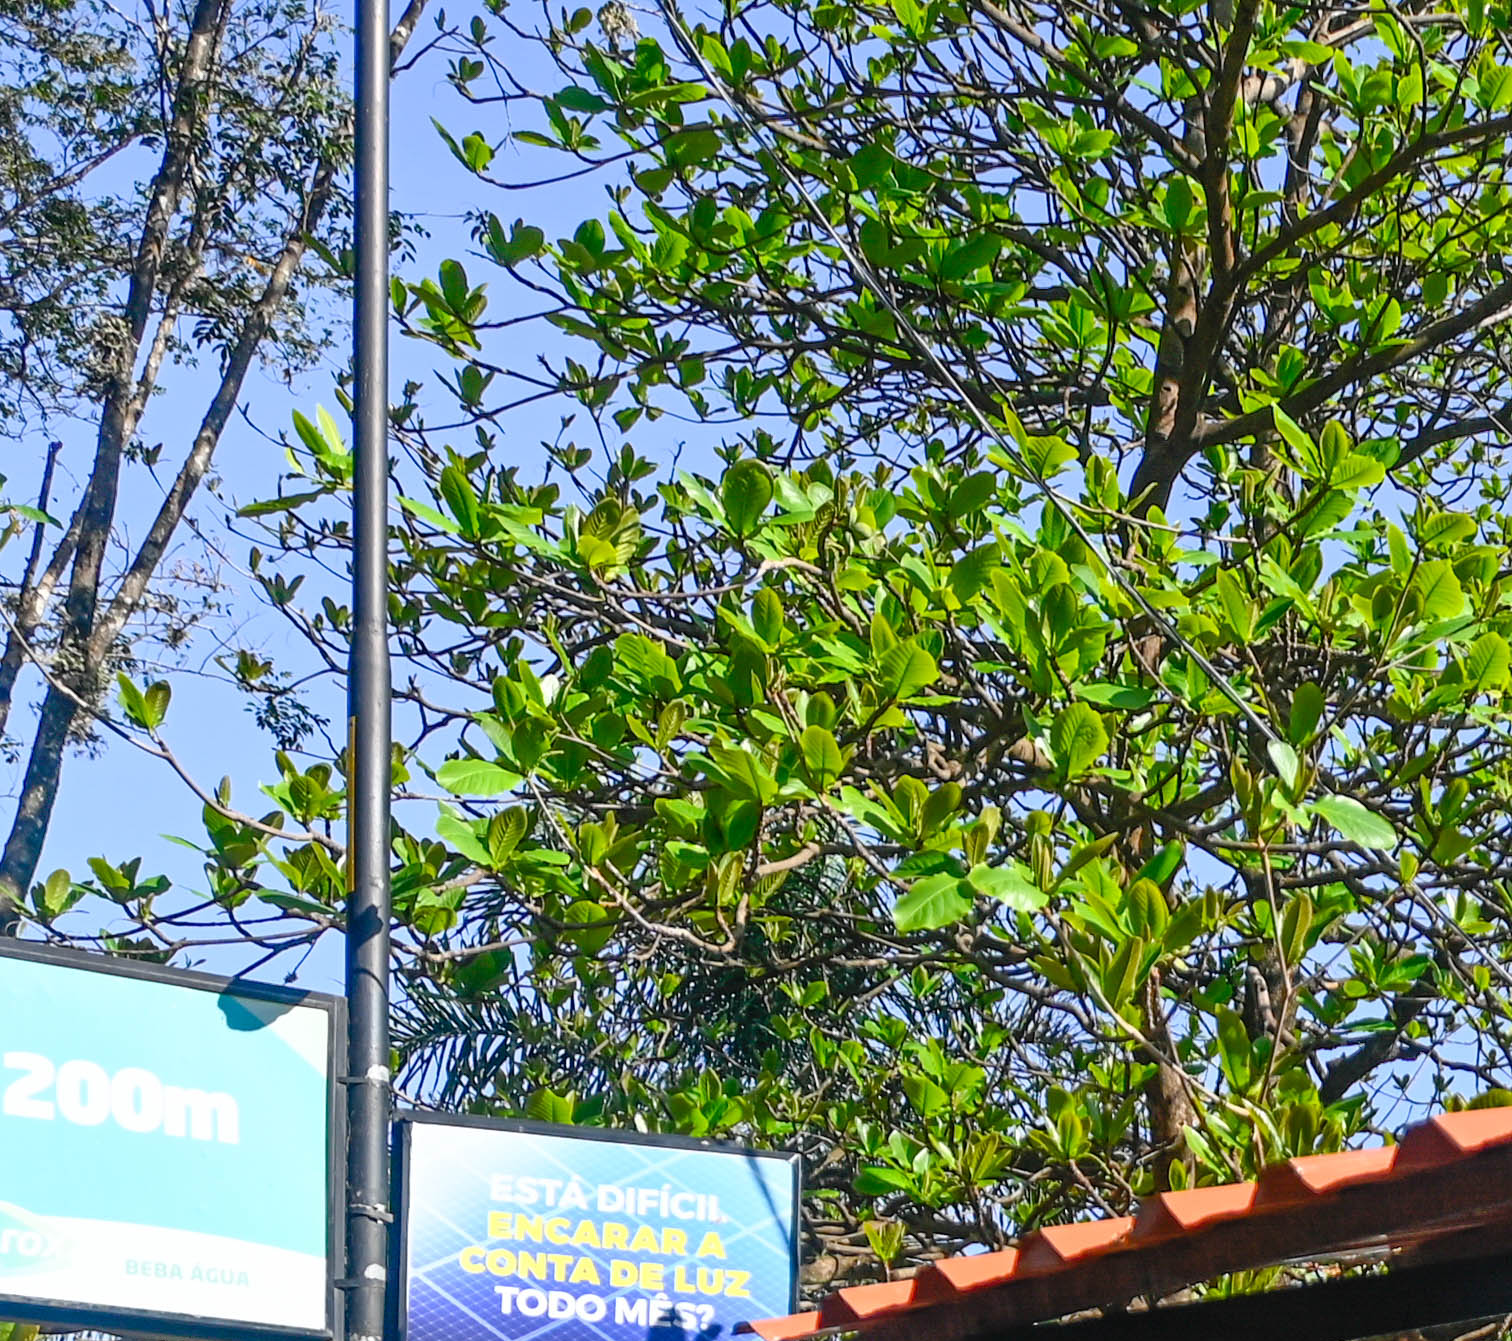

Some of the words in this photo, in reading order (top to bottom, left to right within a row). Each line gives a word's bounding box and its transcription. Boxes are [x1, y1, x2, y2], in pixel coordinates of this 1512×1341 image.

[2, 1051, 240, 1144] 200m
[489, 1173, 587, 1210] ESTÁ
[597, 1184, 728, 1224] DIFÍCIL
[488, 1211, 688, 1256] ENCARAR
[696, 1231, 728, 1259] A
[124, 1259, 183, 1281] BEBA
[190, 1262, 250, 1288] ÁGUA
[459, 1246, 601, 1286] CONTA
[609, 1259, 665, 1291] DE
[674, 1265, 751, 1298] LUZ
[494, 1285, 607, 1323] TODO
[615, 1292, 716, 1331] MÊS?
